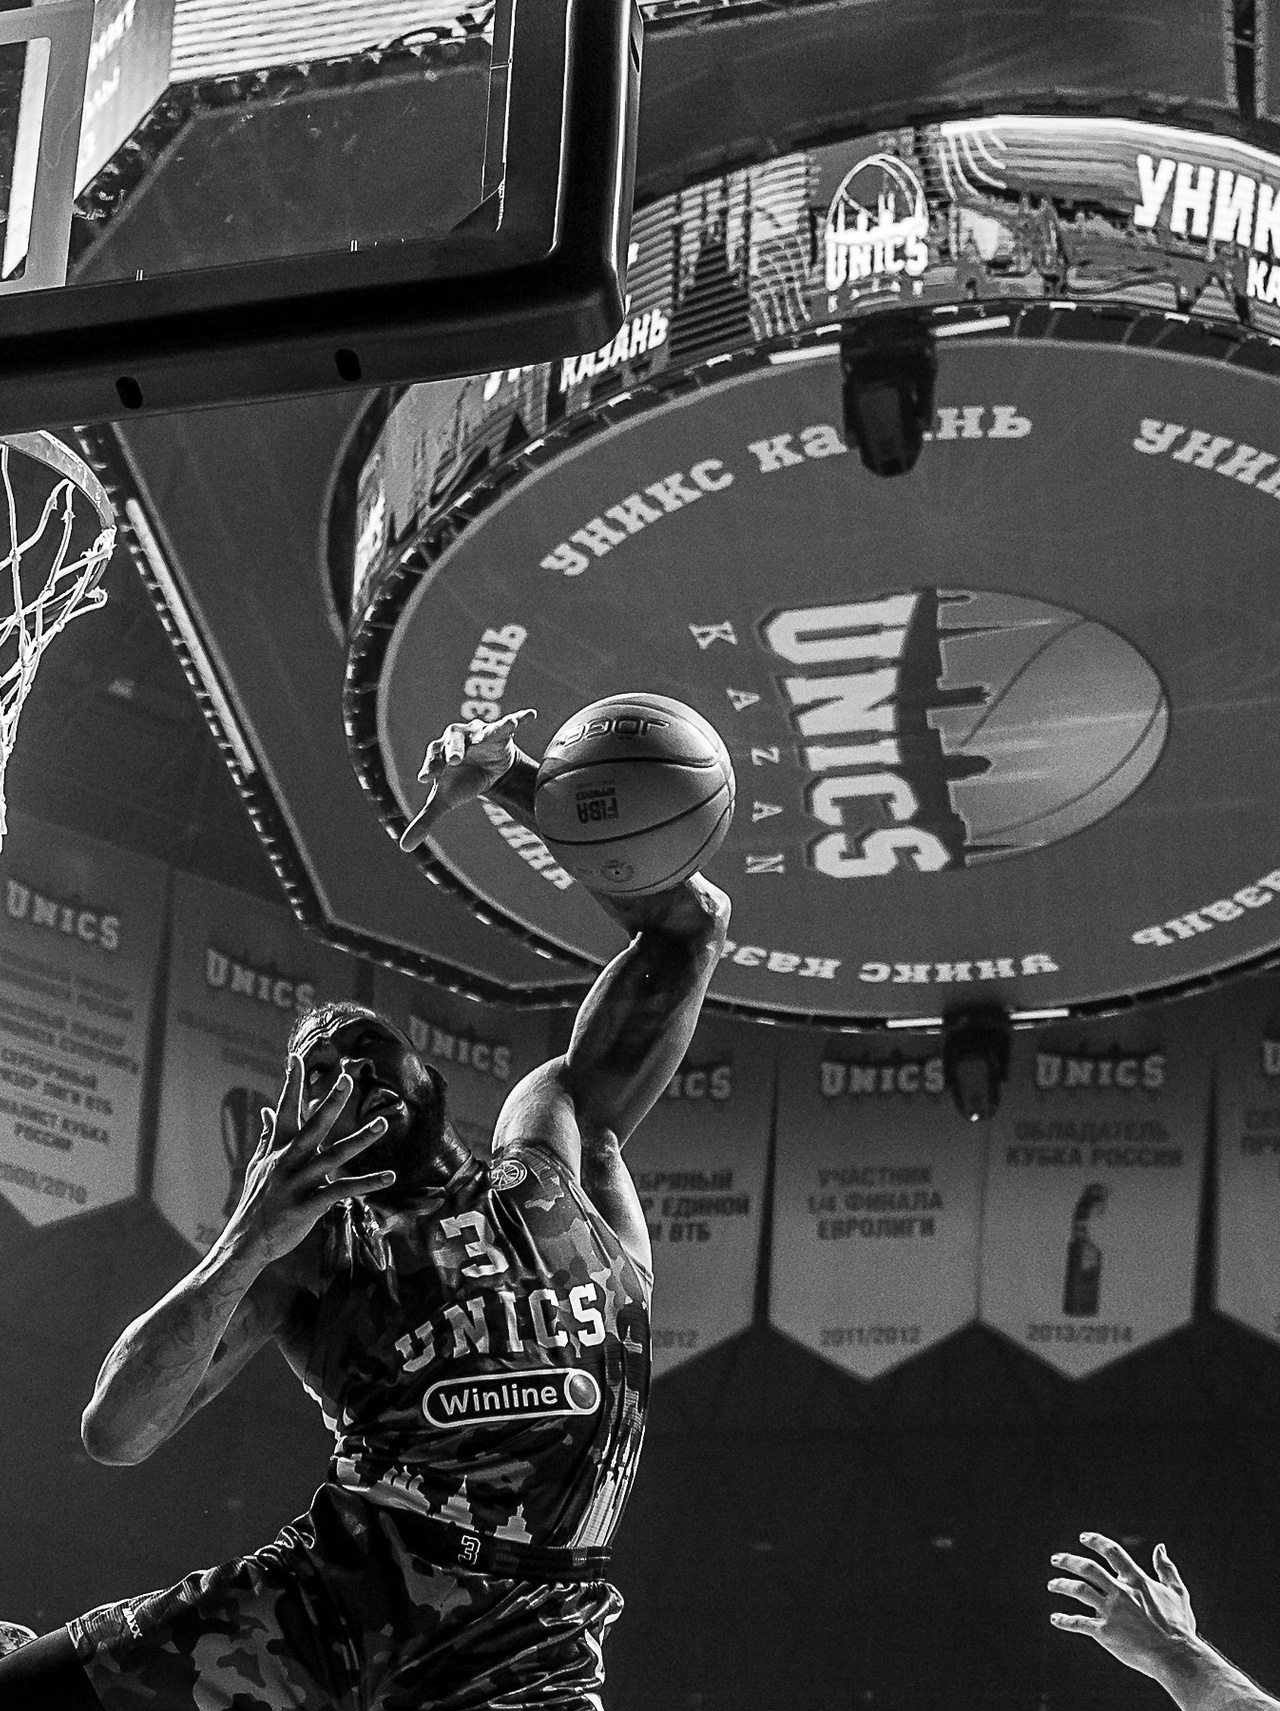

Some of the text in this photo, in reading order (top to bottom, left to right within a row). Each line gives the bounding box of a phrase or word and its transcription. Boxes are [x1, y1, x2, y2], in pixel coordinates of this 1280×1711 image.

[825, 229, 929, 293] UNICS
[688, 621, 785, 874] KAZAN
[766, 594, 951, 879] UNICS
[576, 797, 619, 825] FIBA
[7, 879, 121, 950] UNICS
[205, 948, 315, 1008] UNICS
[668, 1065, 731, 1100] ICS
[820, 1057, 945, 1097] UNICS
[1035, 1052, 1167, 1089] UNICS
[1016, 1120, 1169, 1144] ОБЛАДАТЕЛЬ
[1006, 1147, 1183, 1169] КУБКА РОССИИ
[817, 1166, 933, 1188] УЧАСТНИК
[843, 1189, 944, 1213] ФИНАЛА
[439, 1209, 510, 1279] 3
[669, 1222, 711, 1243] ВТБ
[817, 1215, 936, 1241] ЕВРОЛИГИ
[394, 1282, 607, 1374] UNICS
[821, 1325, 921, 1347] 2011/2012
[1026, 1323, 1133, 1345] 2013/2014
[438, 1383, 559, 1417] Winline
[458, 1534, 481, 1565] 3
